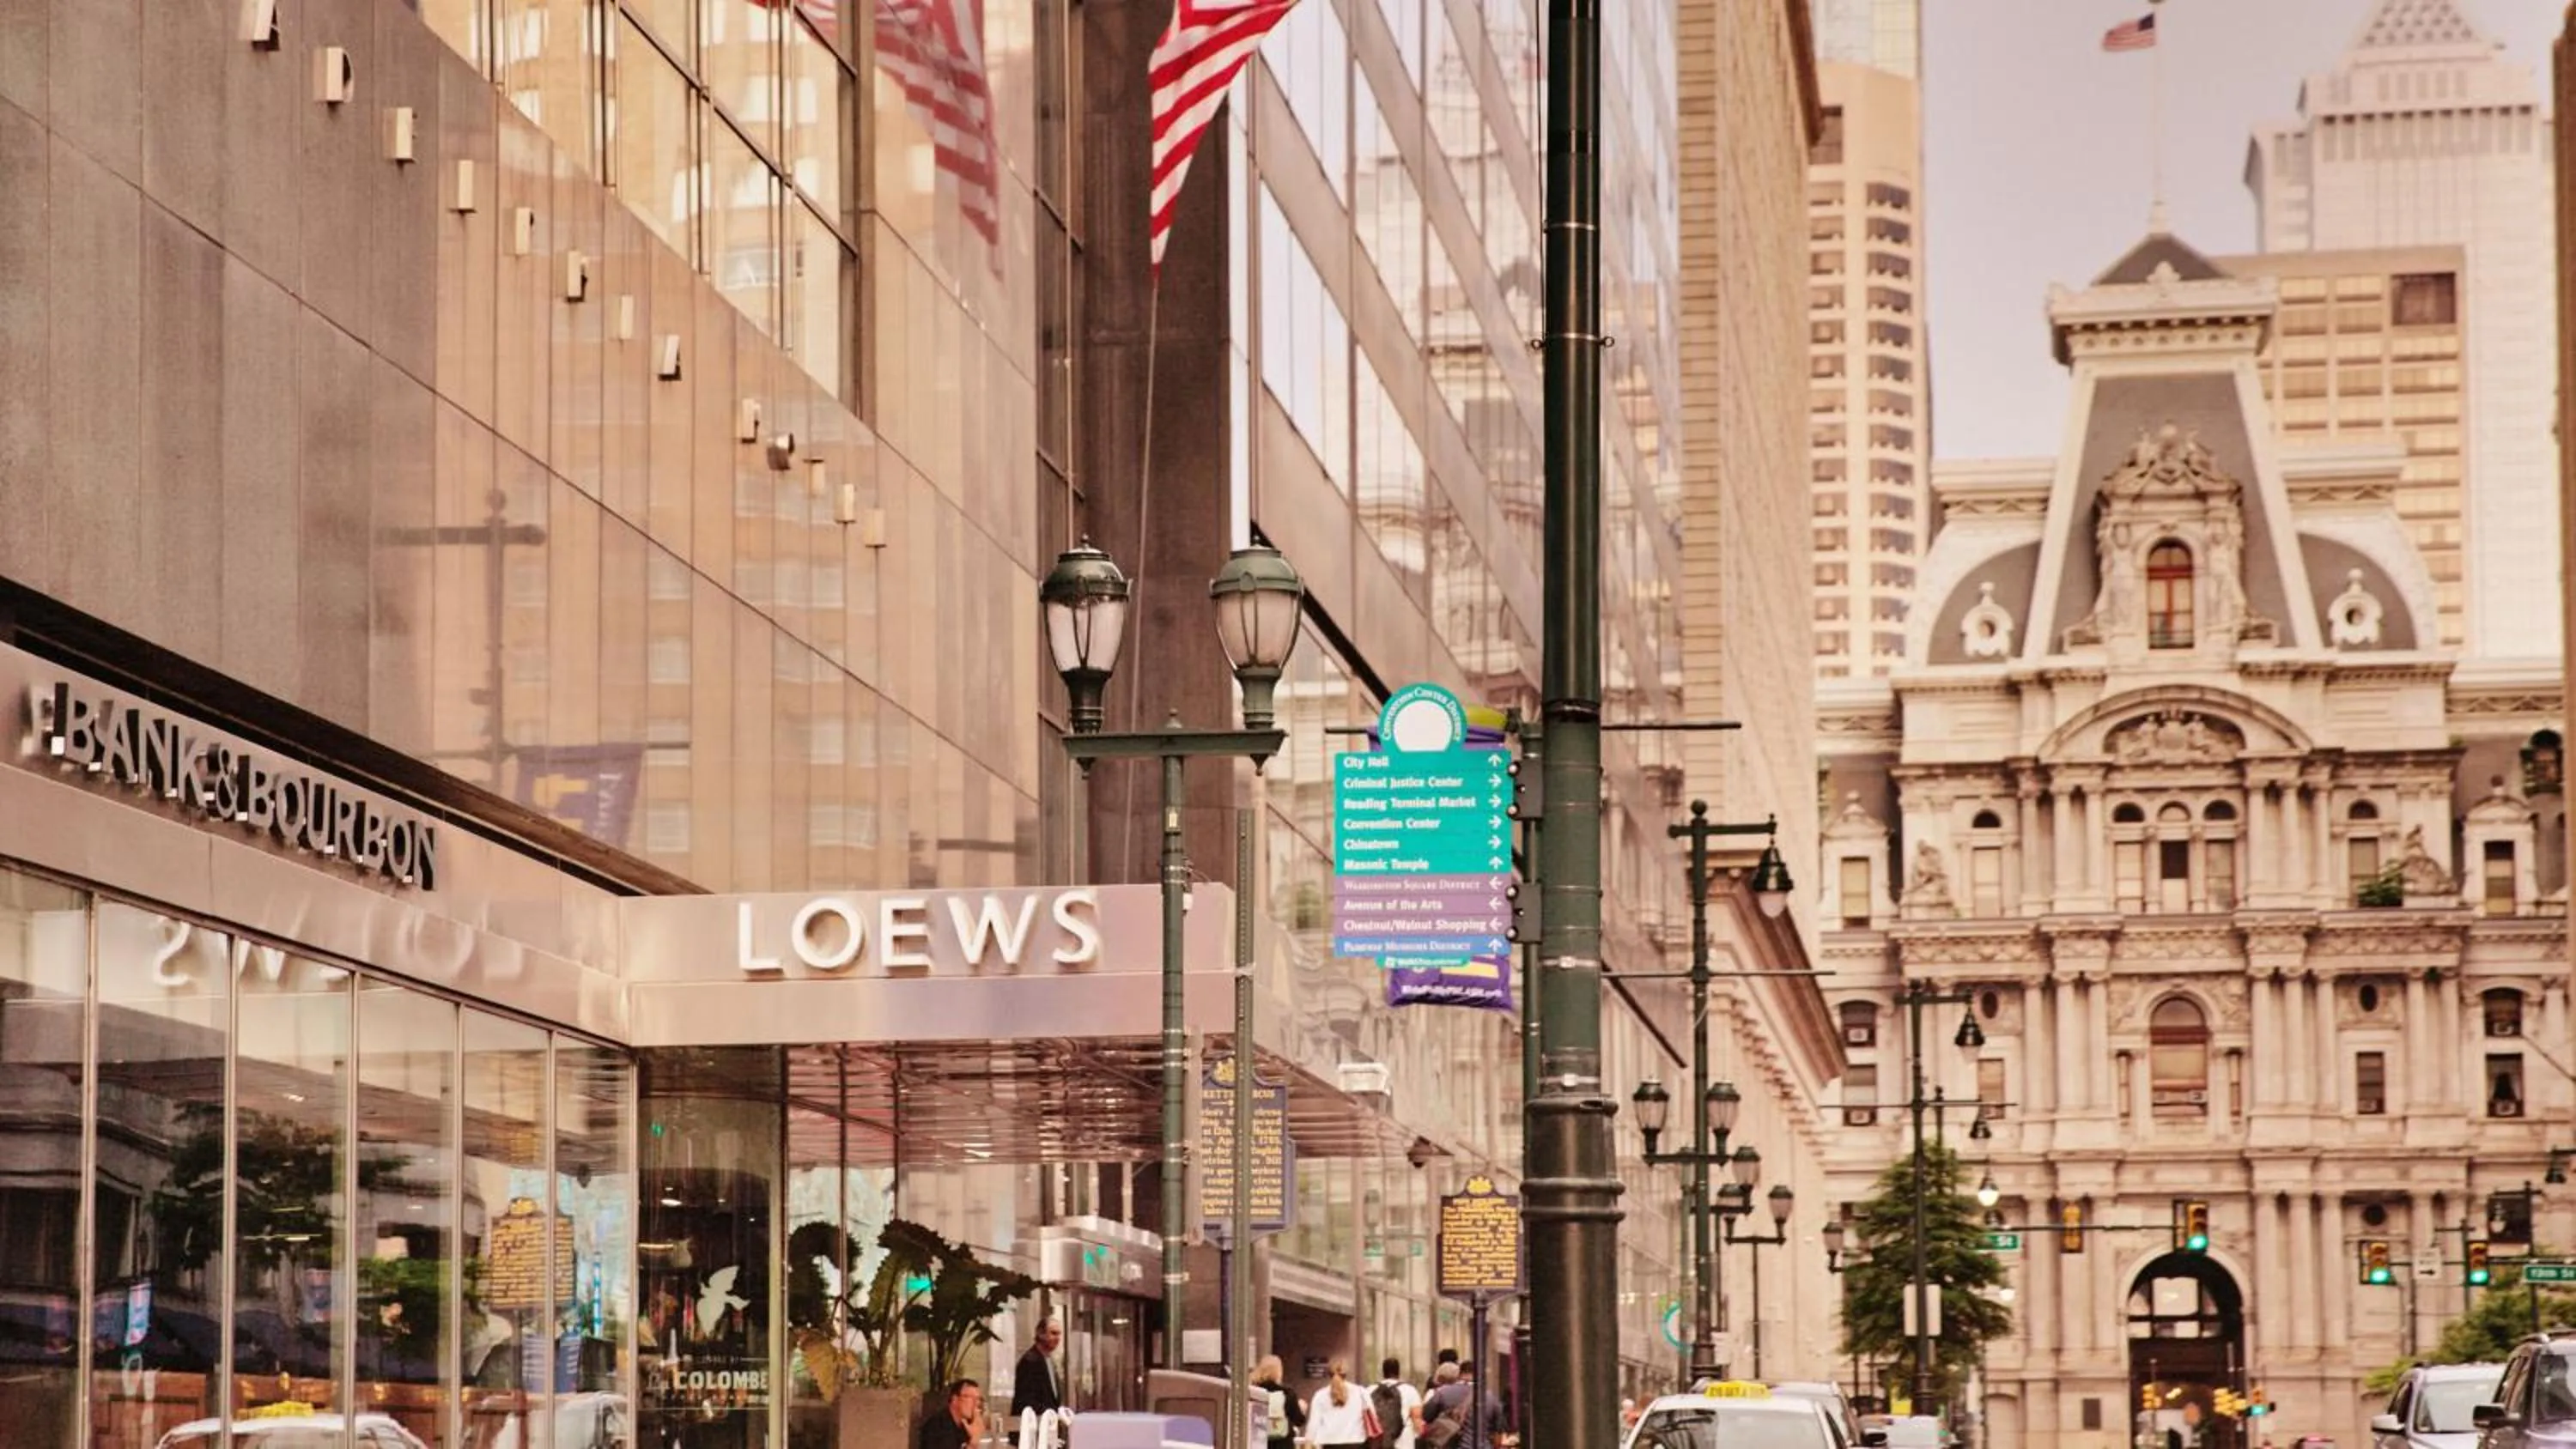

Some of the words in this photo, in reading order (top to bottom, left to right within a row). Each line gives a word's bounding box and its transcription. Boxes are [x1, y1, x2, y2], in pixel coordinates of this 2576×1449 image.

[1343, 756, 1364, 769] City
[1368, 756, 1389, 767] Hall
[1343, 778, 1386, 789] Criminal
[1390, 777, 1425, 788] Justice
[1428, 776, 1463, 787] Center
[1343, 797, 1386, 810] Reading
[1390, 797, 1435, 808] Terminal
[1438, 796, 1476, 807] Market
[1343, 819, 1402, 830] Convention
[1406, 818, 1440, 829] Center
[1343, 839, 1400, 850] Chinatown
[1343, 859, 1388, 870] Masonic
[1391, 858, 1429, 871] Temple
[1344, 900, 1382, 911] Avenue
[1385, 900, 1398, 910] of
[1400, 900, 1419, 910] the
[1420, 900, 1443, 910] Arts
[1344, 919, 1432, 931] Chestnut/Walnut
[1435, 919, 1486, 931] Shopping
[738, 890, 1100, 976] LOEWS
[674, 1370, 768, 1391] COLOMBE
